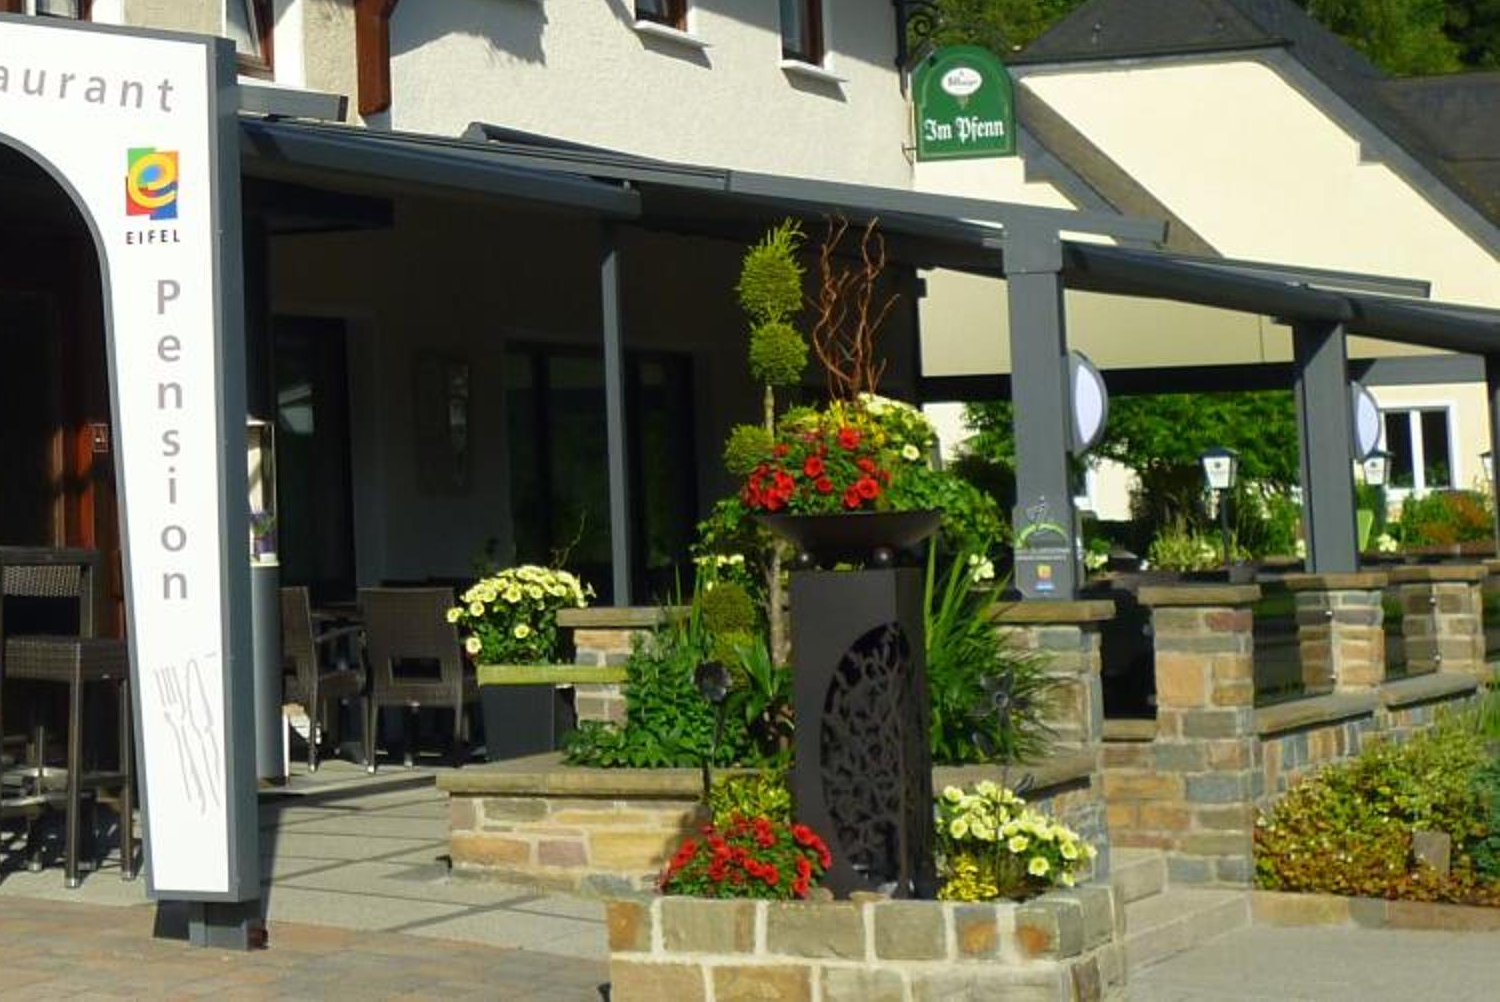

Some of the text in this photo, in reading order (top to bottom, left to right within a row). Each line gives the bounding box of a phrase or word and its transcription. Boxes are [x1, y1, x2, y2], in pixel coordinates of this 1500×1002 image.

[925, 115, 1005, 144] Im Pfenn
[126, 229, 181, 246] EIFEL
[156, 279, 189, 600] Pension
